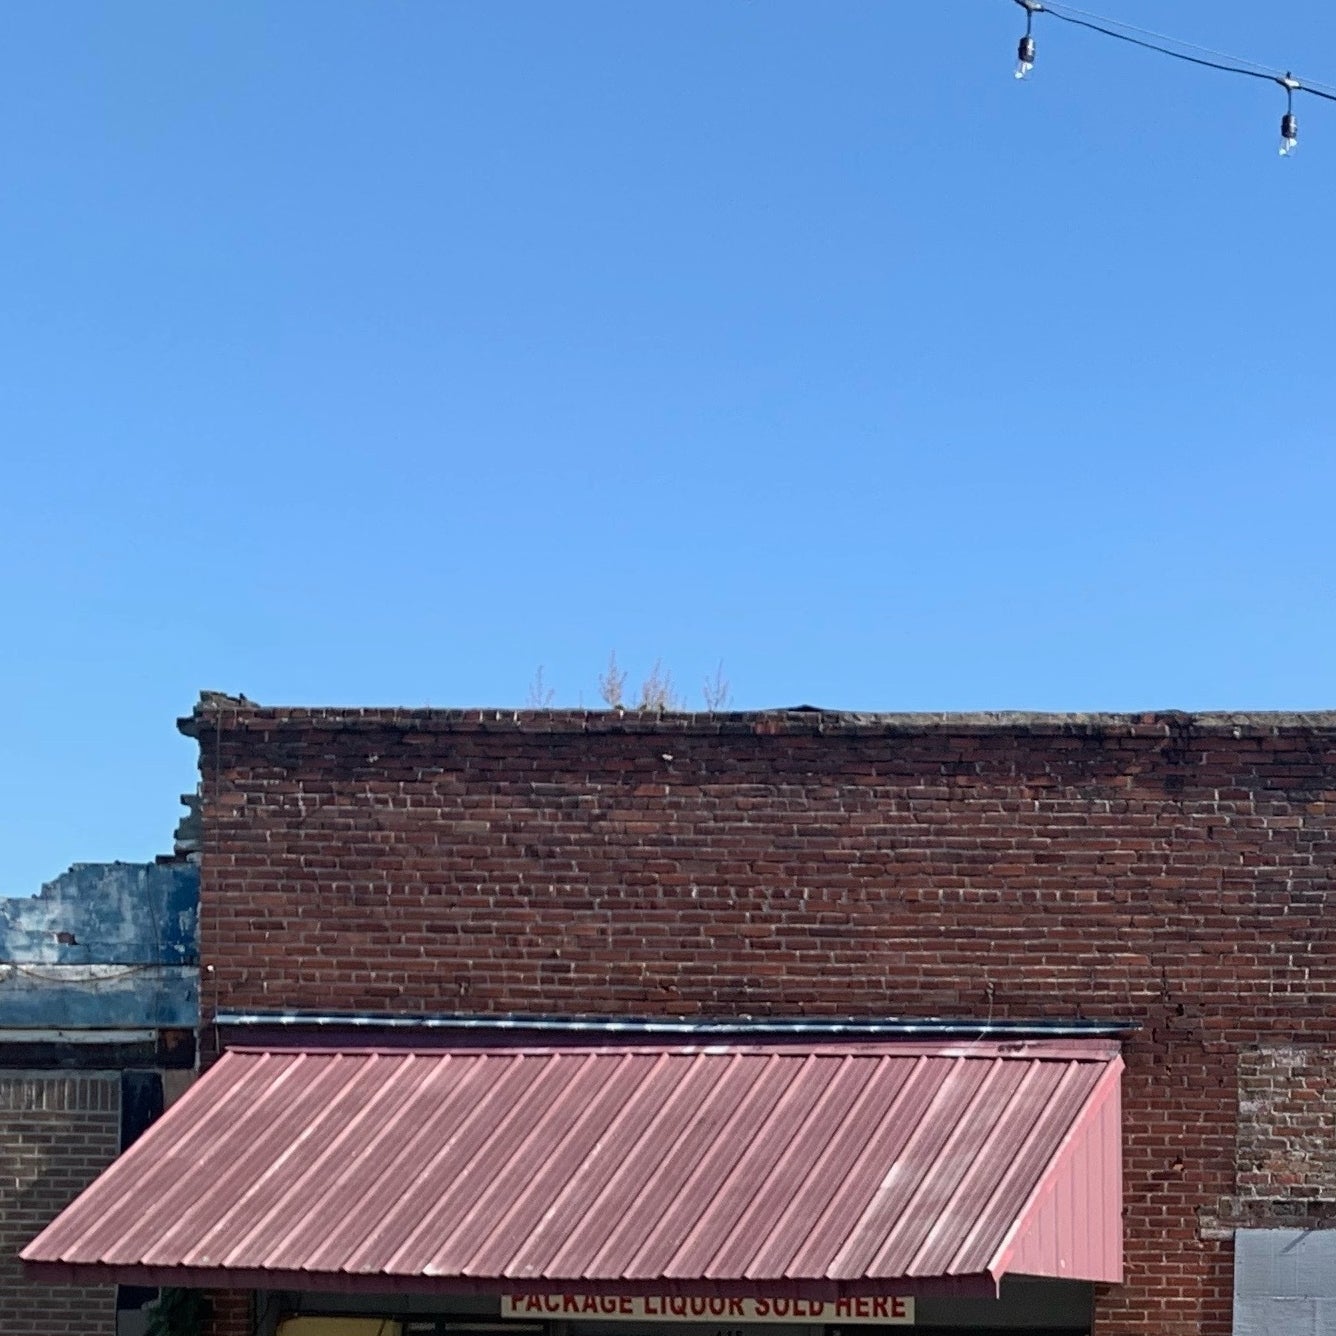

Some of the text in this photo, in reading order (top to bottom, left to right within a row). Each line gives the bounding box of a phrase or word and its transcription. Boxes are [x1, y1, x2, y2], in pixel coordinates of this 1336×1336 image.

[511, 1294, 906, 1317] PACKAGE LIQUOR SOLD HERE
